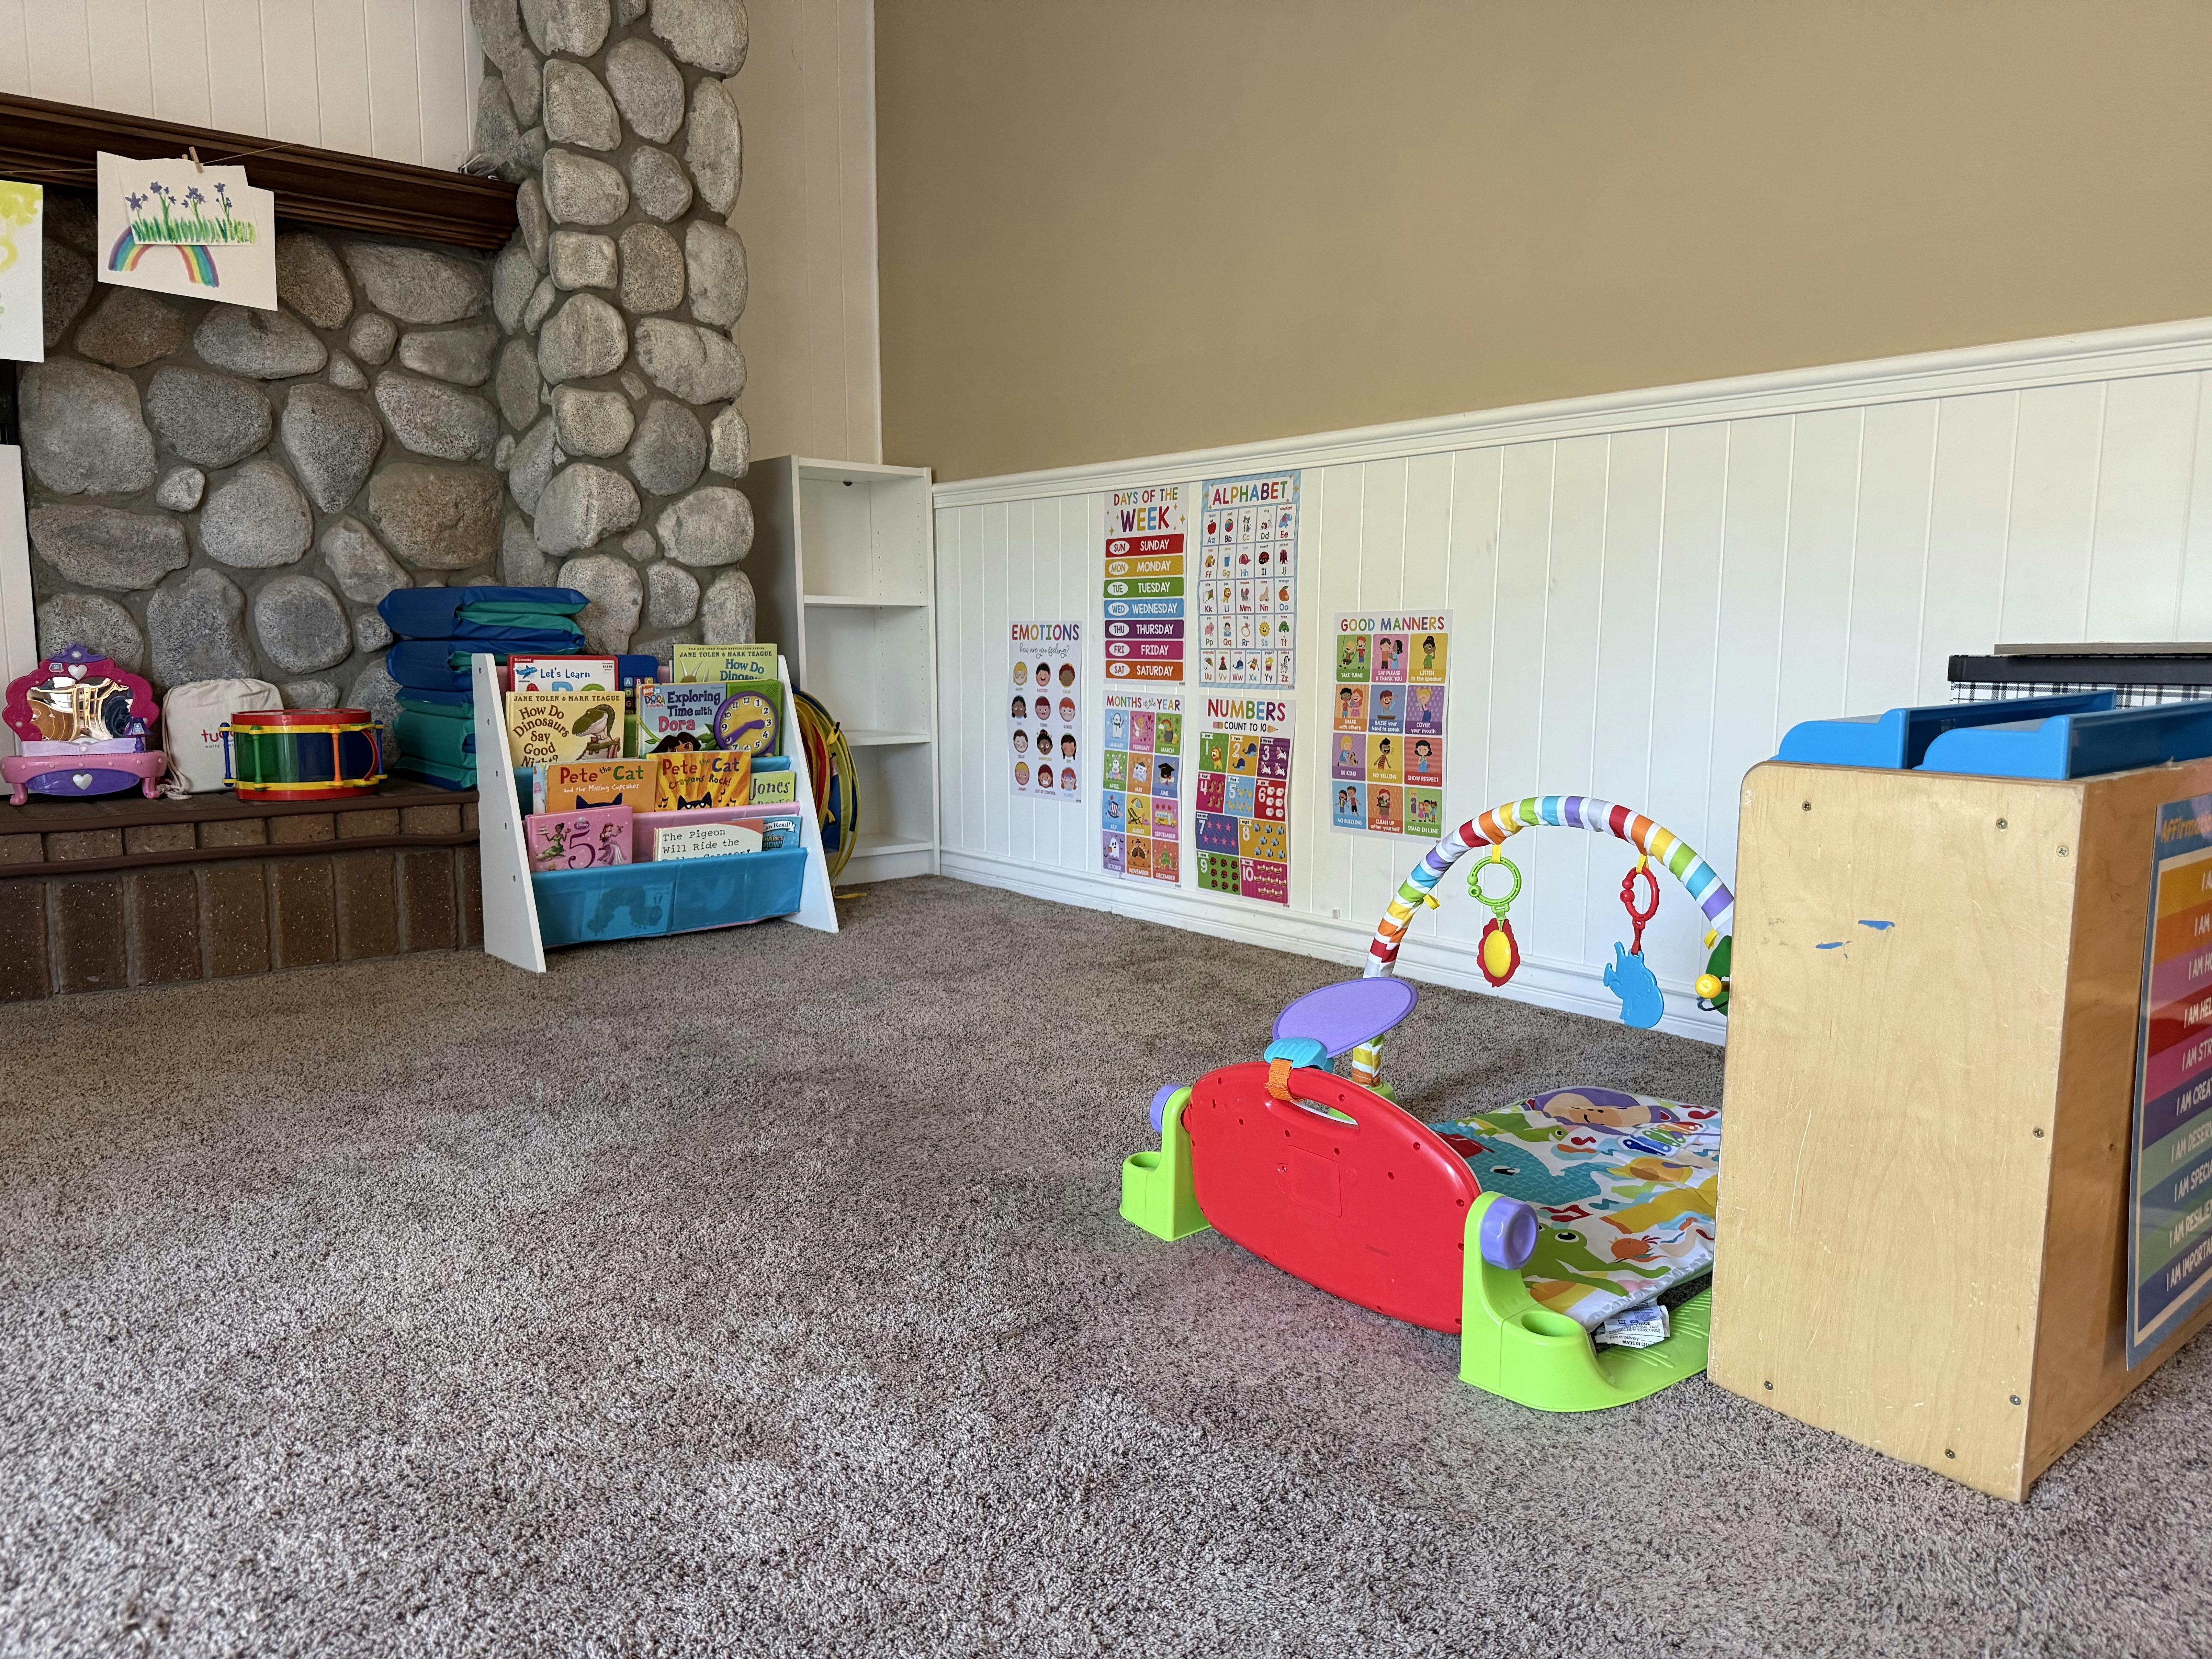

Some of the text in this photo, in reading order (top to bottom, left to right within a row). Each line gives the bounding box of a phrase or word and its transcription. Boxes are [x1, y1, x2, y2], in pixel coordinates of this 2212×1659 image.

[1114, 487, 1178, 506] DAYS OF THE
[1212, 481, 1288, 505] ALPHABET
[1120, 506, 1170, 532] WEEK
[1280, 531, 1288, 539] Ee
[1114, 539, 1170, 552] SUN SUNDAY
[1111, 560, 1171, 572] MON MONDAY
[1222, 569, 1230, 578] Gg
[1240, 569, 1249, 577] Hh
[1281, 566, 1286, 575] Jj
[1113, 582, 1170, 593] TUE TUESDAY
[1112, 603, 1178, 614] WED WEDNESDAY
[1260, 604, 1268, 612] Nn
[1114, 624, 1174, 635] THU THURSDAY
[1341, 616, 1444, 632] GOOD MANNERS
[1012, 624, 1079, 641] EMOTIONS
[1114, 644, 1169, 656] FRI FRIDAY
[1206, 638, 1213, 647] Pp
[1223, 639, 1232, 647] Qq
[1019, 642, 1029, 653] how
[1036, 649, 1047, 659] you
[1048, 643, 1070, 658] feeling?
[541, 667, 590, 679] Let's Learn
[725, 658, 764, 674] How Do
[1114, 665, 1173, 676] SAT SATURDAY
[1264, 673, 1273, 683] Yy
[644, 694, 665, 705] DORA
[667, 689, 720, 706] Exploring
[1106, 696, 1180, 711] MONTHS of the YEAR
[519, 704, 564, 720] How Do
[667, 705, 713, 717] Time with
[1207, 698, 1286, 722] NUMBERS
[513, 718, 569, 738] Dinosaurs
[658, 716, 696, 733] Dora
[1224, 721, 1266, 732] COUNT TO 10
[531, 730, 551, 744] Say
[524, 742, 556, 756] Good
[1232, 743, 1241, 758] 2
[1262, 745, 1270, 761] 3
[663, 759, 697, 776] Pete
[712, 757, 740, 772] Cat
[560, 766, 644, 784] Pete the Cat
[709, 773, 732, 786] Rock!
[749, 778, 790, 800] Jones
[1200, 780, 1207, 795] 4
[1229, 783, 1236, 799] 5
[1199, 819, 1205, 834] 7
[1242, 826, 1250, 841] 8
[663, 829, 725, 842] The Pigeon
[1154, 831, 1176, 839] SEPTEMBER
[568, 829, 596, 869] 5
[663, 845, 687, 854] Will
[693, 841, 718, 851] Ride
[1200, 859, 1207, 873] 9
[1156, 872, 1175, 881] DECEMBER
[1243, 866, 1254, 882] 10
[2188, 1003, 2198, 1025] AM
[2186, 1046, 2197, 1070] AM
[2180, 1091, 2191, 1113] AM
[2178, 1175, 2189, 1200] AM
